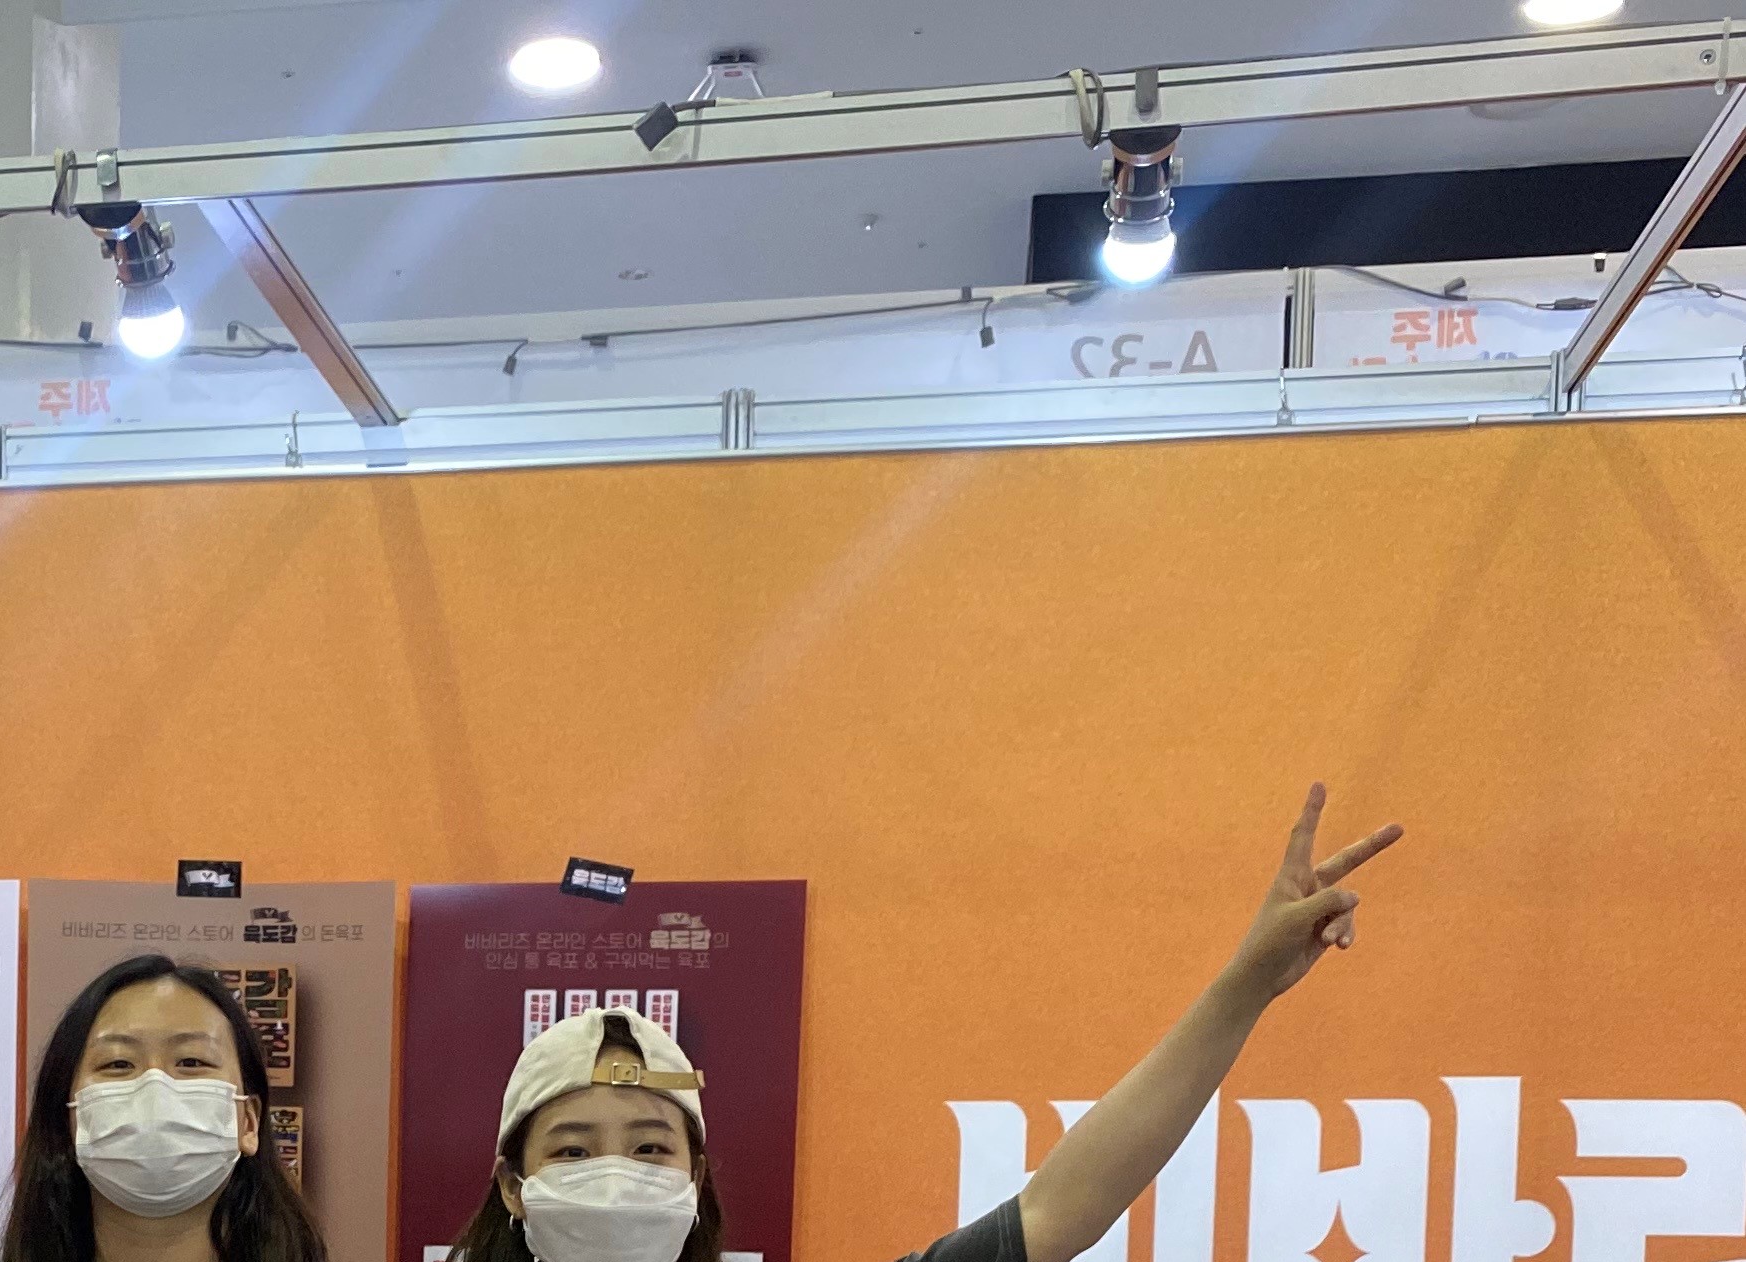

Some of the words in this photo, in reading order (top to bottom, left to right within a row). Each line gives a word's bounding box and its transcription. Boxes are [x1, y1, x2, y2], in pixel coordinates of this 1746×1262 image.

[133, 923, 181, 941] 온라인
[187, 924, 234, 942] 스토어
[321, 924, 364, 942] 돈육포
[536, 932, 586, 950] 온라인
[592, 932, 642, 950] 스토어
[547, 952, 579, 970] 육포
[585, 952, 598, 970] &
[605, 952, 671, 970] 구워먹는
[678, 952, 710, 970] 육포
